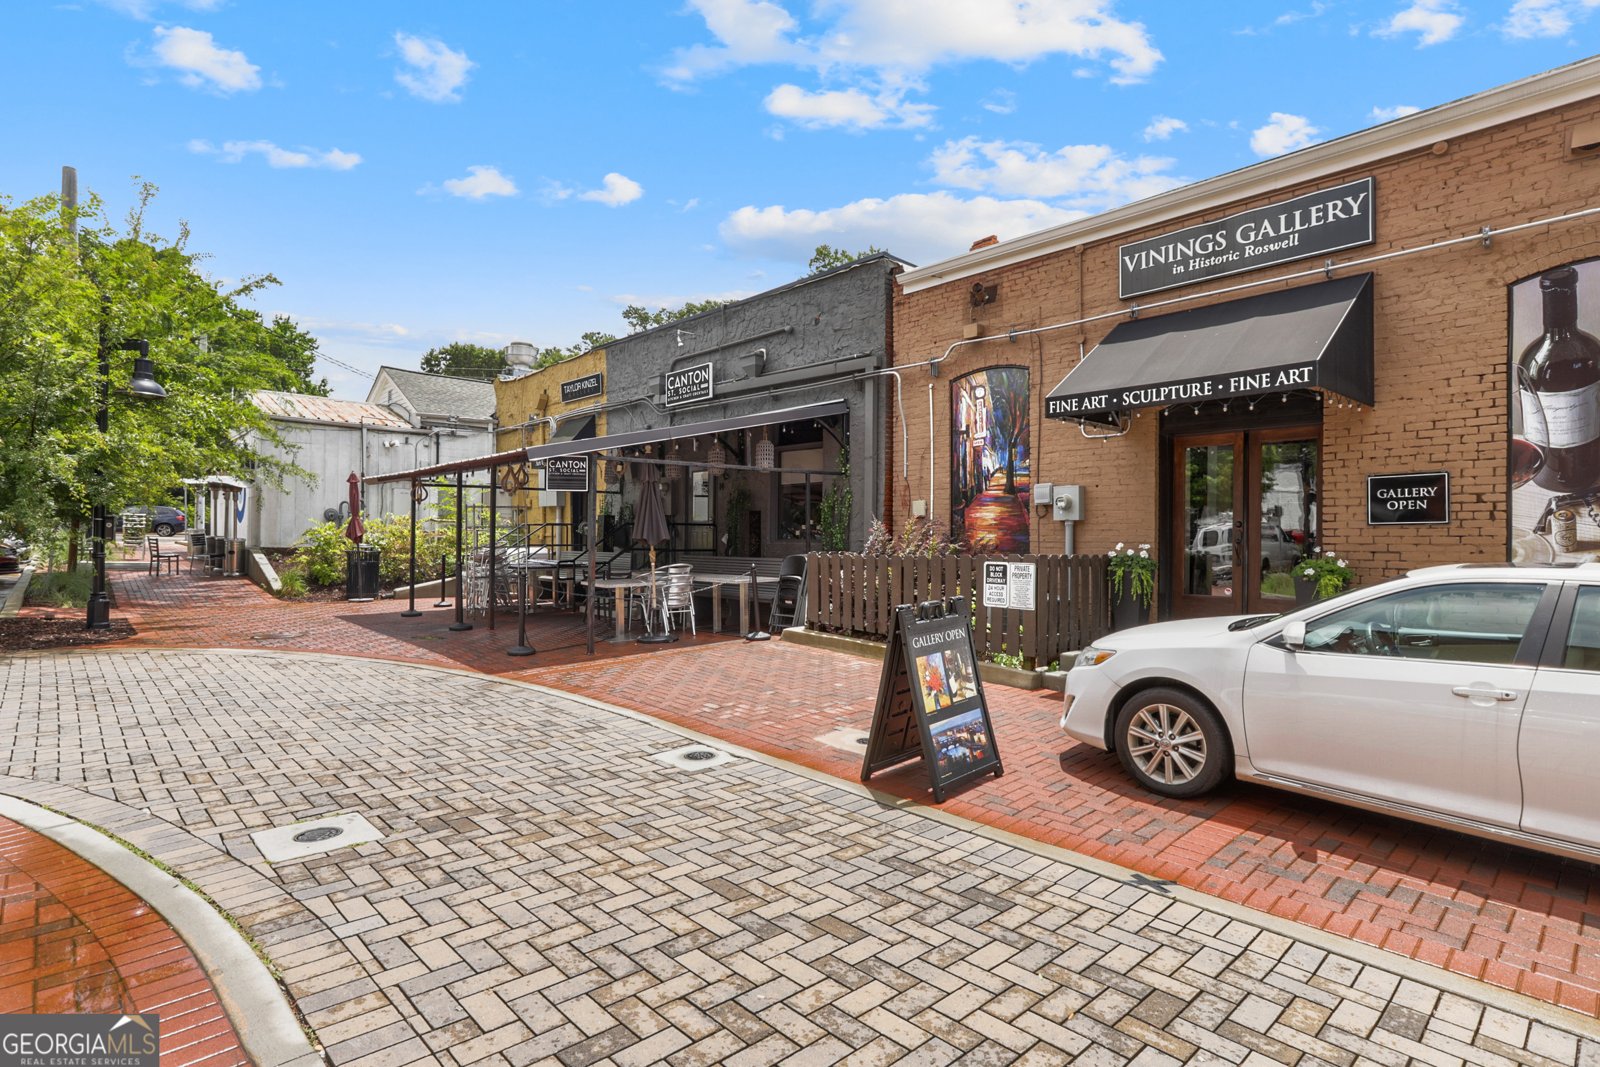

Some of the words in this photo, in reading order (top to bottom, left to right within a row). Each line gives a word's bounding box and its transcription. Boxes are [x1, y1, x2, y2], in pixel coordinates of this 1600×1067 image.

[1123, 230, 1227, 273] VININGS
[1235, 192, 1368, 244] GALLERY
[1172, 264, 1185, 275] in
[1188, 250, 1240, 271] Historic
[1244, 233, 1300, 258] Roswell
[668, 368, 708, 390] CANTON
[667, 389, 676, 397] ST.
[679, 383, 700, 395] SOCIAL
[1049, 398, 1079, 413] FINE
[1081, 394, 1109, 410] ART
[1122, 381, 1213, 406] SCULPTURE
[1229, 372, 1271, 392] FINE
[1274, 366, 1313, 387] ART
[549, 460, 586, 469] CANTON
[1377, 487, 1437, 498] GALLERY
[1387, 500, 1427, 510] OPEN
[912, 632, 944, 648] GALLERY
[945, 628, 966, 641] OPEN
